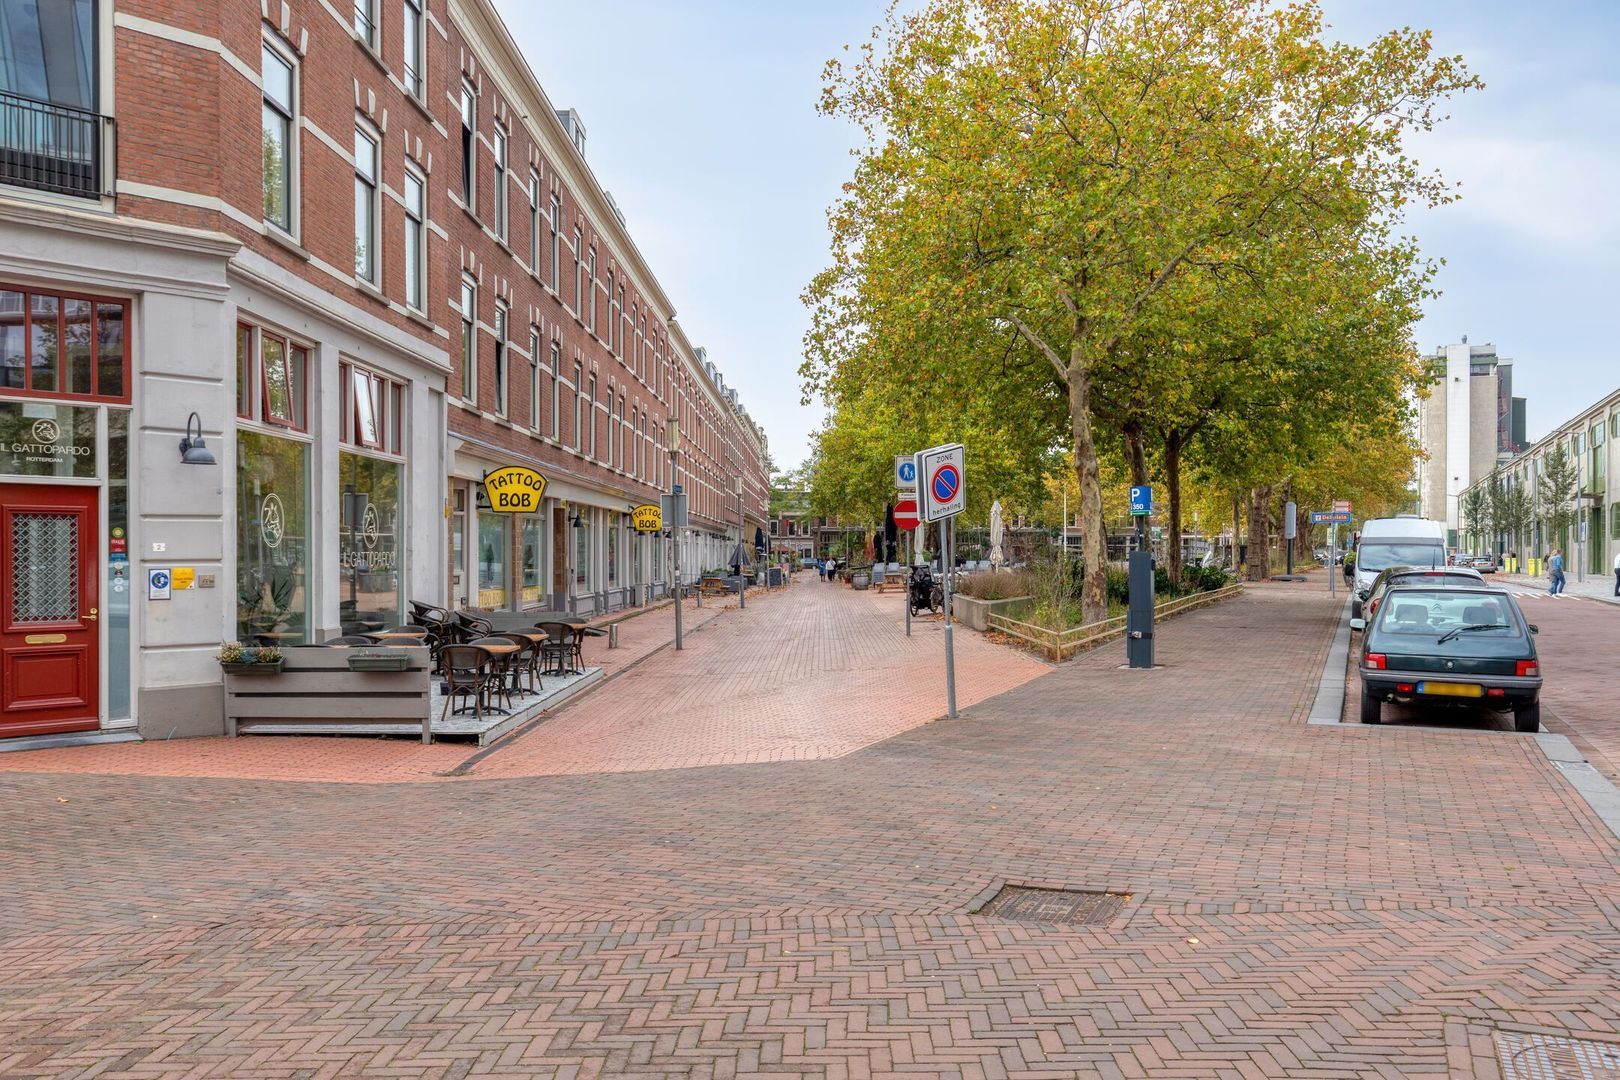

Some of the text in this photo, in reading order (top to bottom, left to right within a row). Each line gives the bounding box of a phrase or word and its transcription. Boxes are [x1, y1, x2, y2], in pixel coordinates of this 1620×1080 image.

[0, 442, 91, 456] IL GATTOPARDO
[936, 453, 953, 463] ZONE
[489, 472, 542, 491] TATTOO
[499, 493, 531, 507] BOB
[1131, 488, 1140, 502] P
[932, 503, 961, 515] herhaling
[639, 520, 657, 528] BOB
